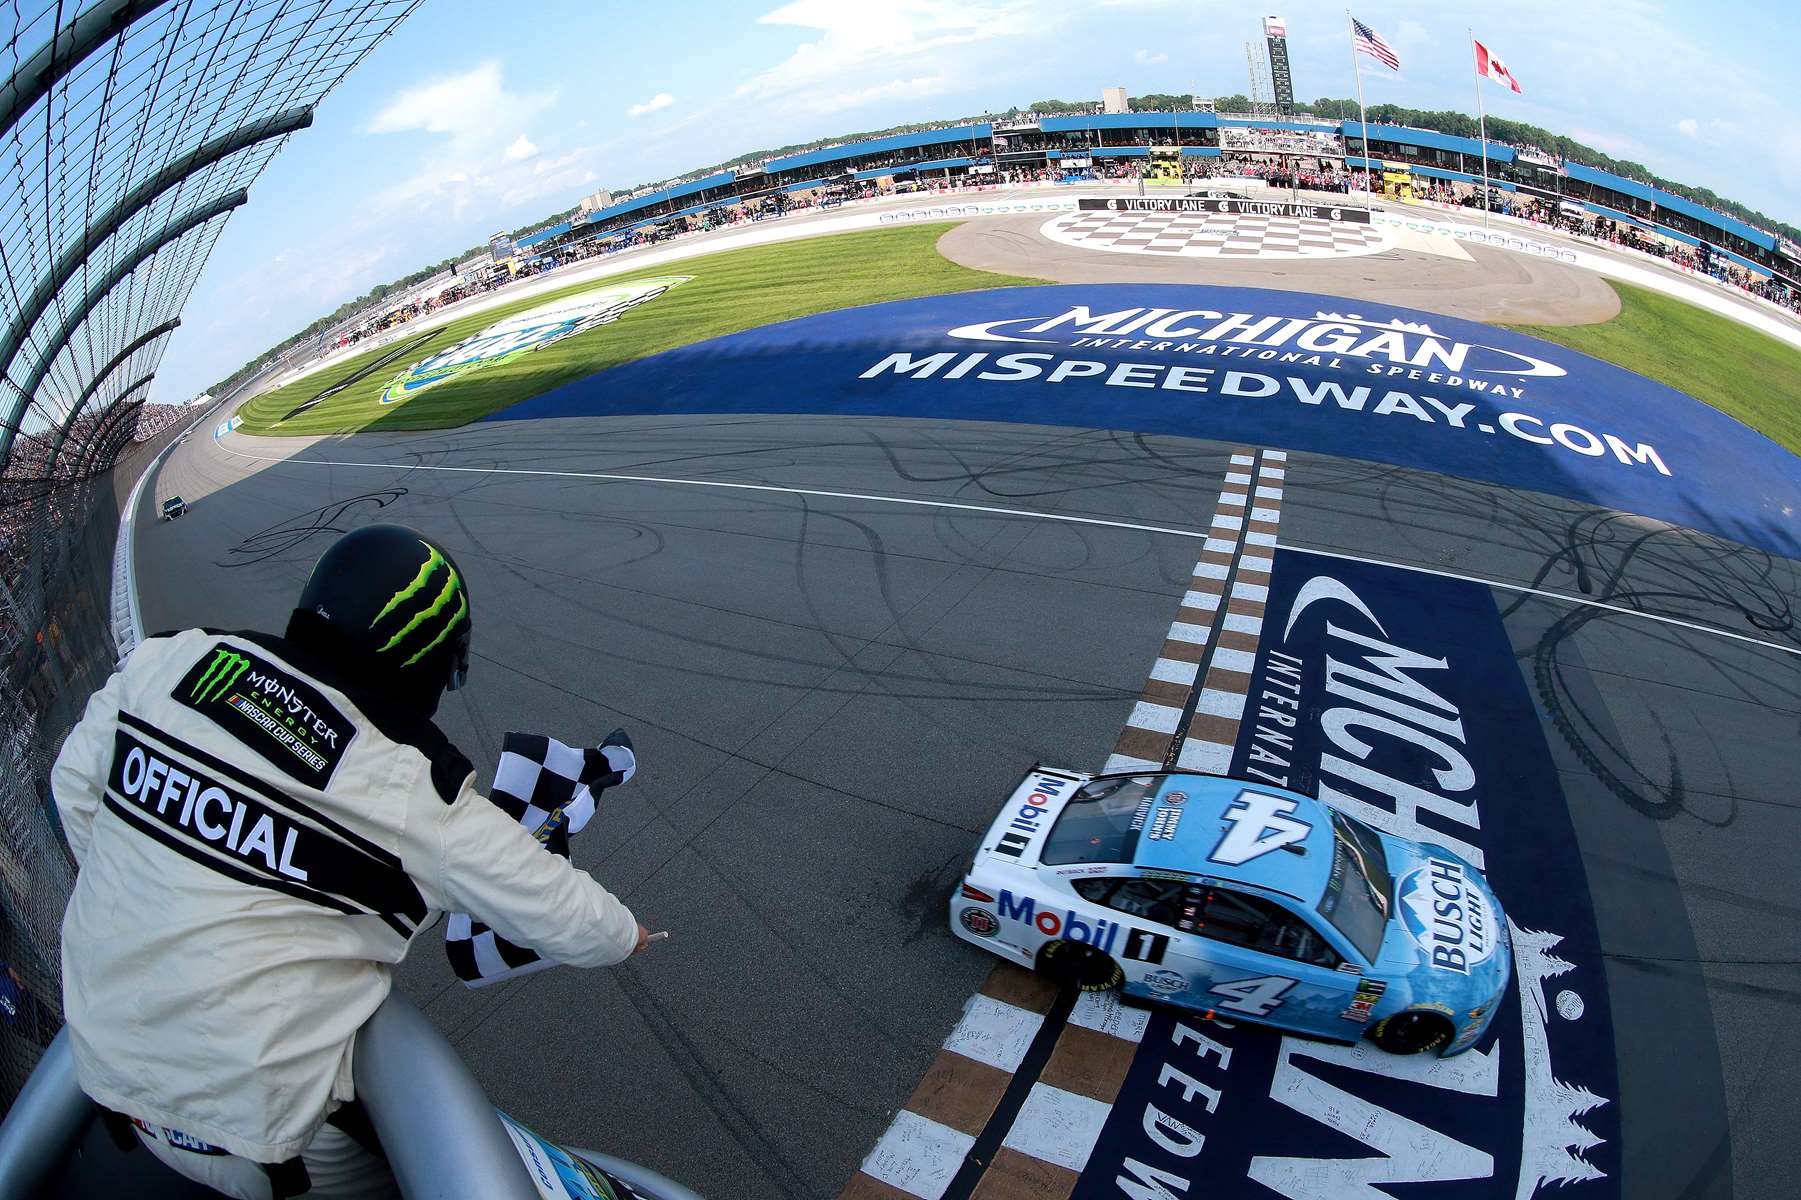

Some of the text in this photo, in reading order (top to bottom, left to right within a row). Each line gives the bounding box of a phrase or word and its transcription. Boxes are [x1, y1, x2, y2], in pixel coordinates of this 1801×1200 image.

[1125, 199, 1174, 212] VICTORY
[1175, 200, 1206, 212] LANE
[1237, 201, 1287, 216] VICTORY
[1288, 204, 1319, 218] LANE
[1019, 305, 1472, 372] MICHIGAN
[1069, 337, 1527, 399] INTERNATIONAL SPEEDWAY
[858, 352, 1672, 476] MISPEEDWAY.COM
[237, 700, 326, 771] NASCAR CUP SERIES
[246, 671, 338, 749] MONSTER
[251, 691, 318, 745] ENERGY
[123, 747, 308, 881] OFFICIAL
[1010, 777, 1066, 832] Mobil
[1207, 788, 1313, 866] 4
[998, 889, 1120, 954] Mobil
[1429, 857, 1470, 976] BUSCH
[1465, 887, 1484, 953] LIGHT
[1143, 972, 1190, 992] BUSCH
[1208, 975, 1300, 1017] 4
